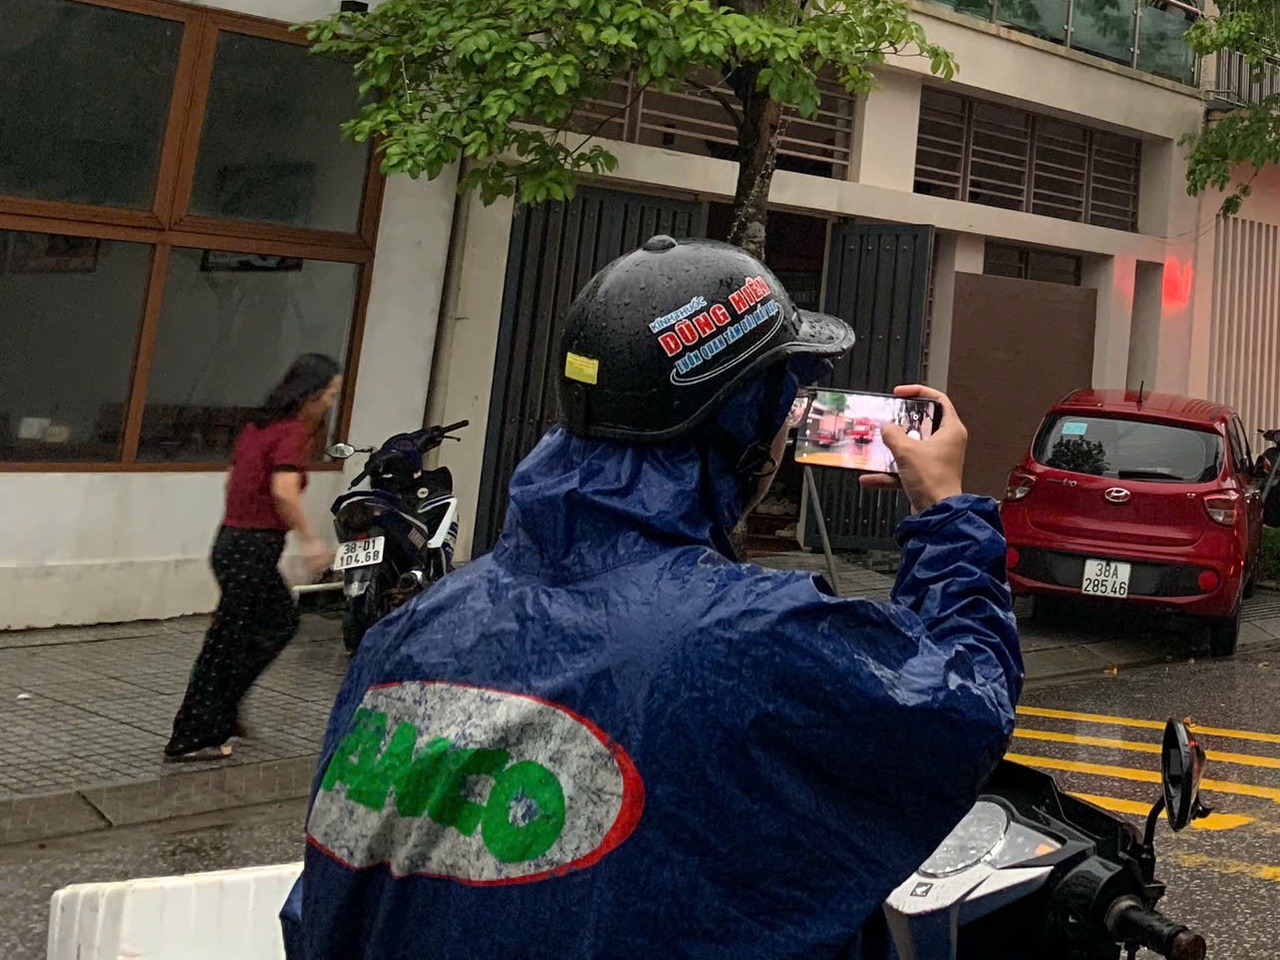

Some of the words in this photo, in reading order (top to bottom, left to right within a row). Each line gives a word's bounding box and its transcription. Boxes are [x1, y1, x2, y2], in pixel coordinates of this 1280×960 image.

[658, 304, 731, 357] DŨNG
[1095, 563, 1119, 579] 38A
[1083, 578, 1127, 596] 285.46
